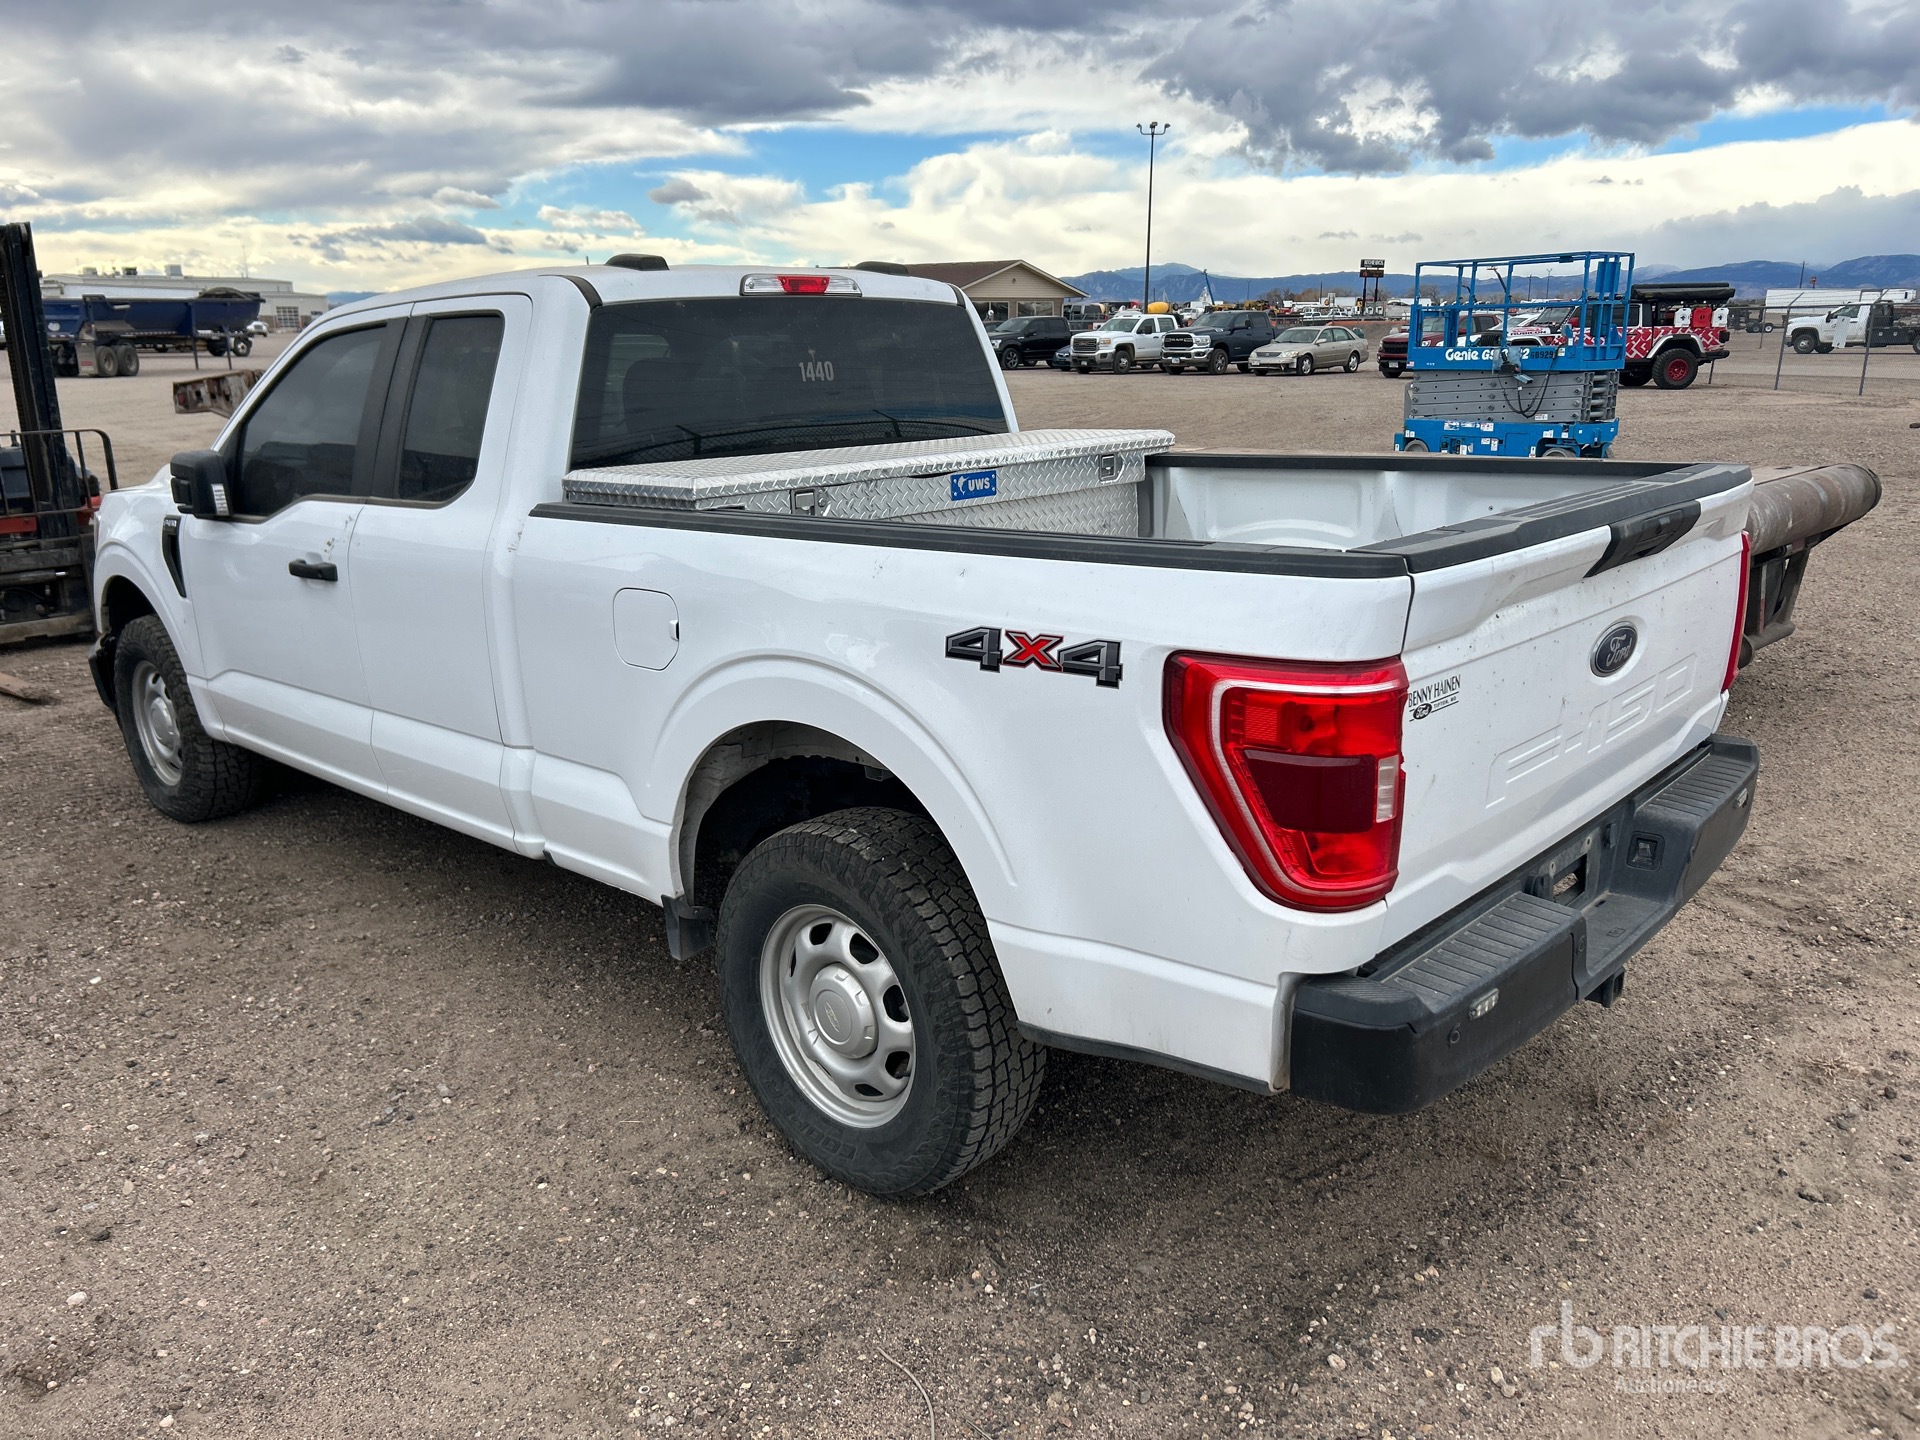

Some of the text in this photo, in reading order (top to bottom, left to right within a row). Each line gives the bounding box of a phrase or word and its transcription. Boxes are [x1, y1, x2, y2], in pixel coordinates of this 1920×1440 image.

[1445, 348, 1480, 361] Genie
[799, 360, 834, 382] 1440
[968, 476, 991, 492] UWS
[1605, 632, 1634, 668] Ford
[1409, 674, 1461, 707] BENNY HAINEN
[1485, 652, 1698, 810] F-150
